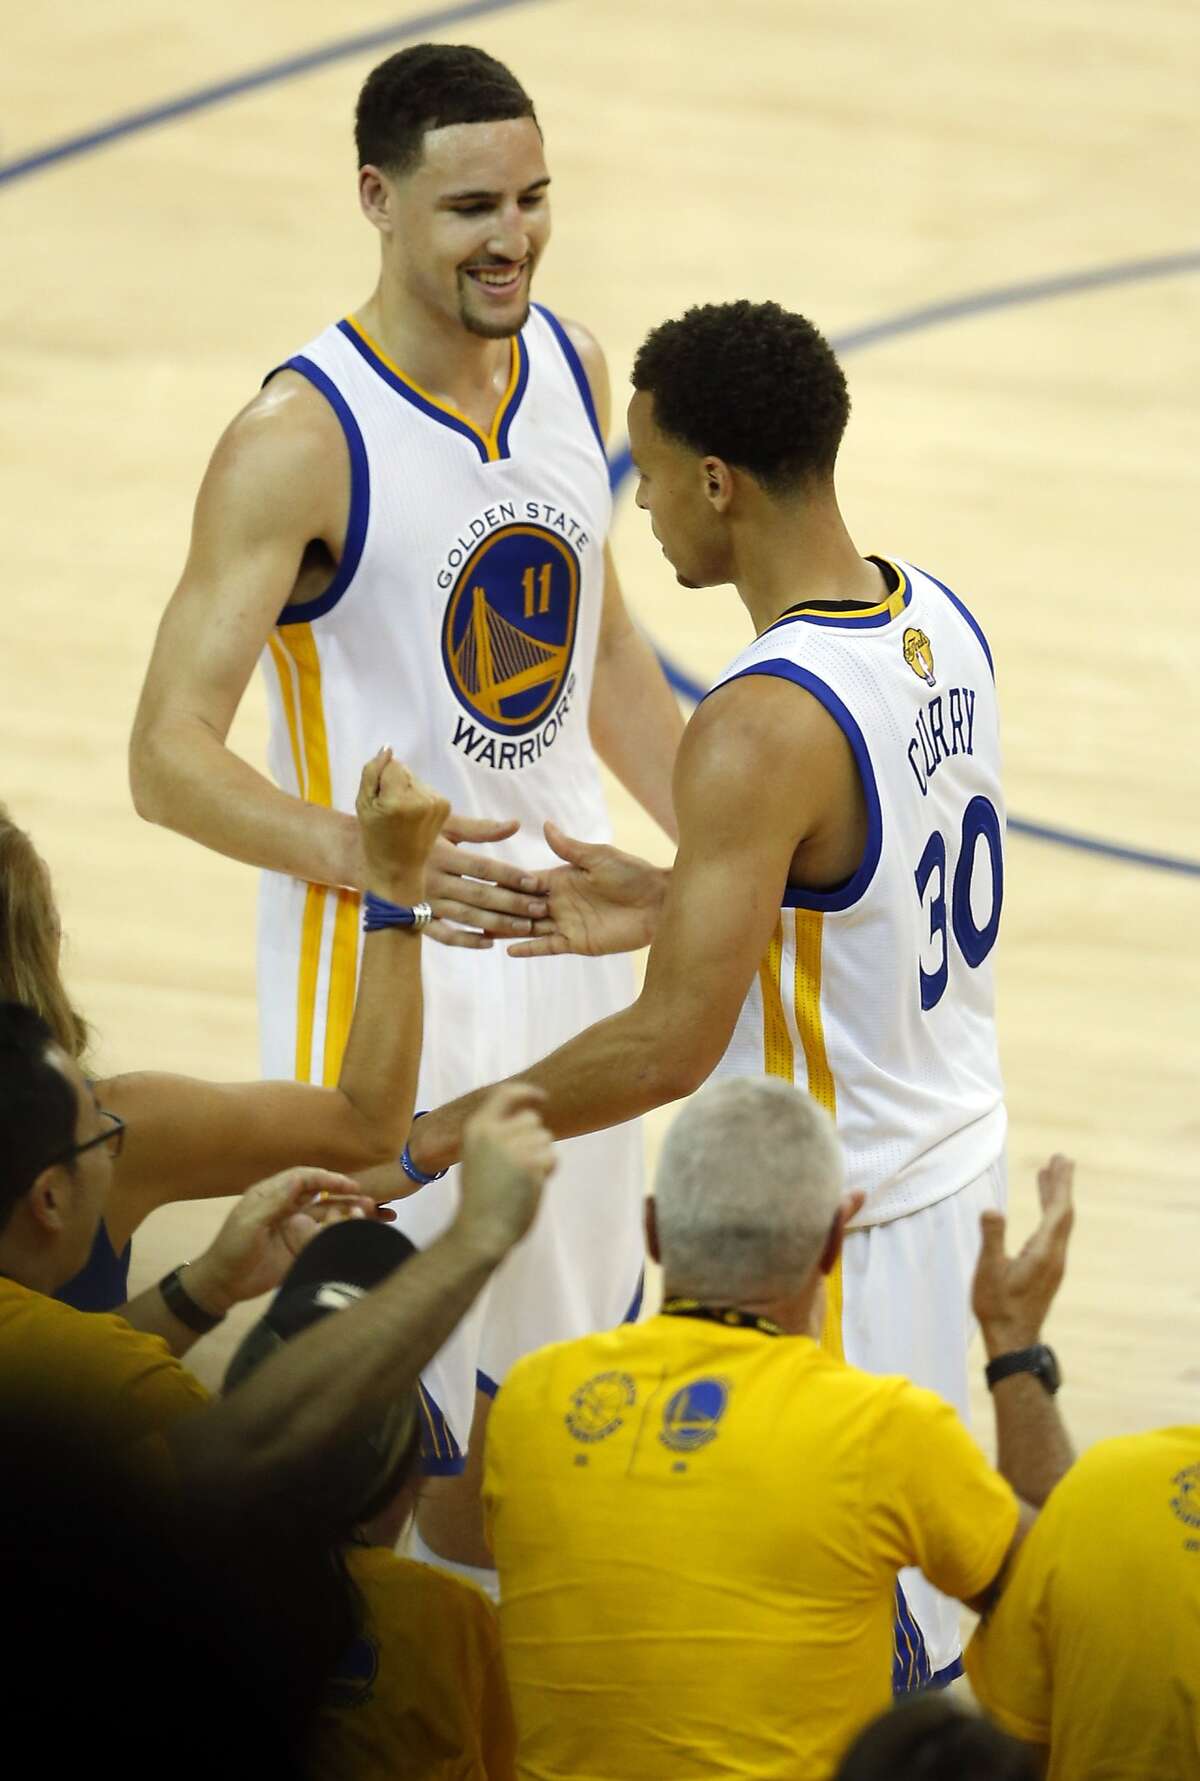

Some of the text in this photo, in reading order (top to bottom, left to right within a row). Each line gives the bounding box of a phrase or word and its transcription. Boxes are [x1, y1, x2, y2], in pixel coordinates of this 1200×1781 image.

[437, 502, 589, 589] GOLDEN STATE
[521, 562, 552, 619] 11
[452, 673, 576, 770] WARRIORS
[908, 688, 975, 796] CURRY
[914, 795, 1003, 1011] 30
